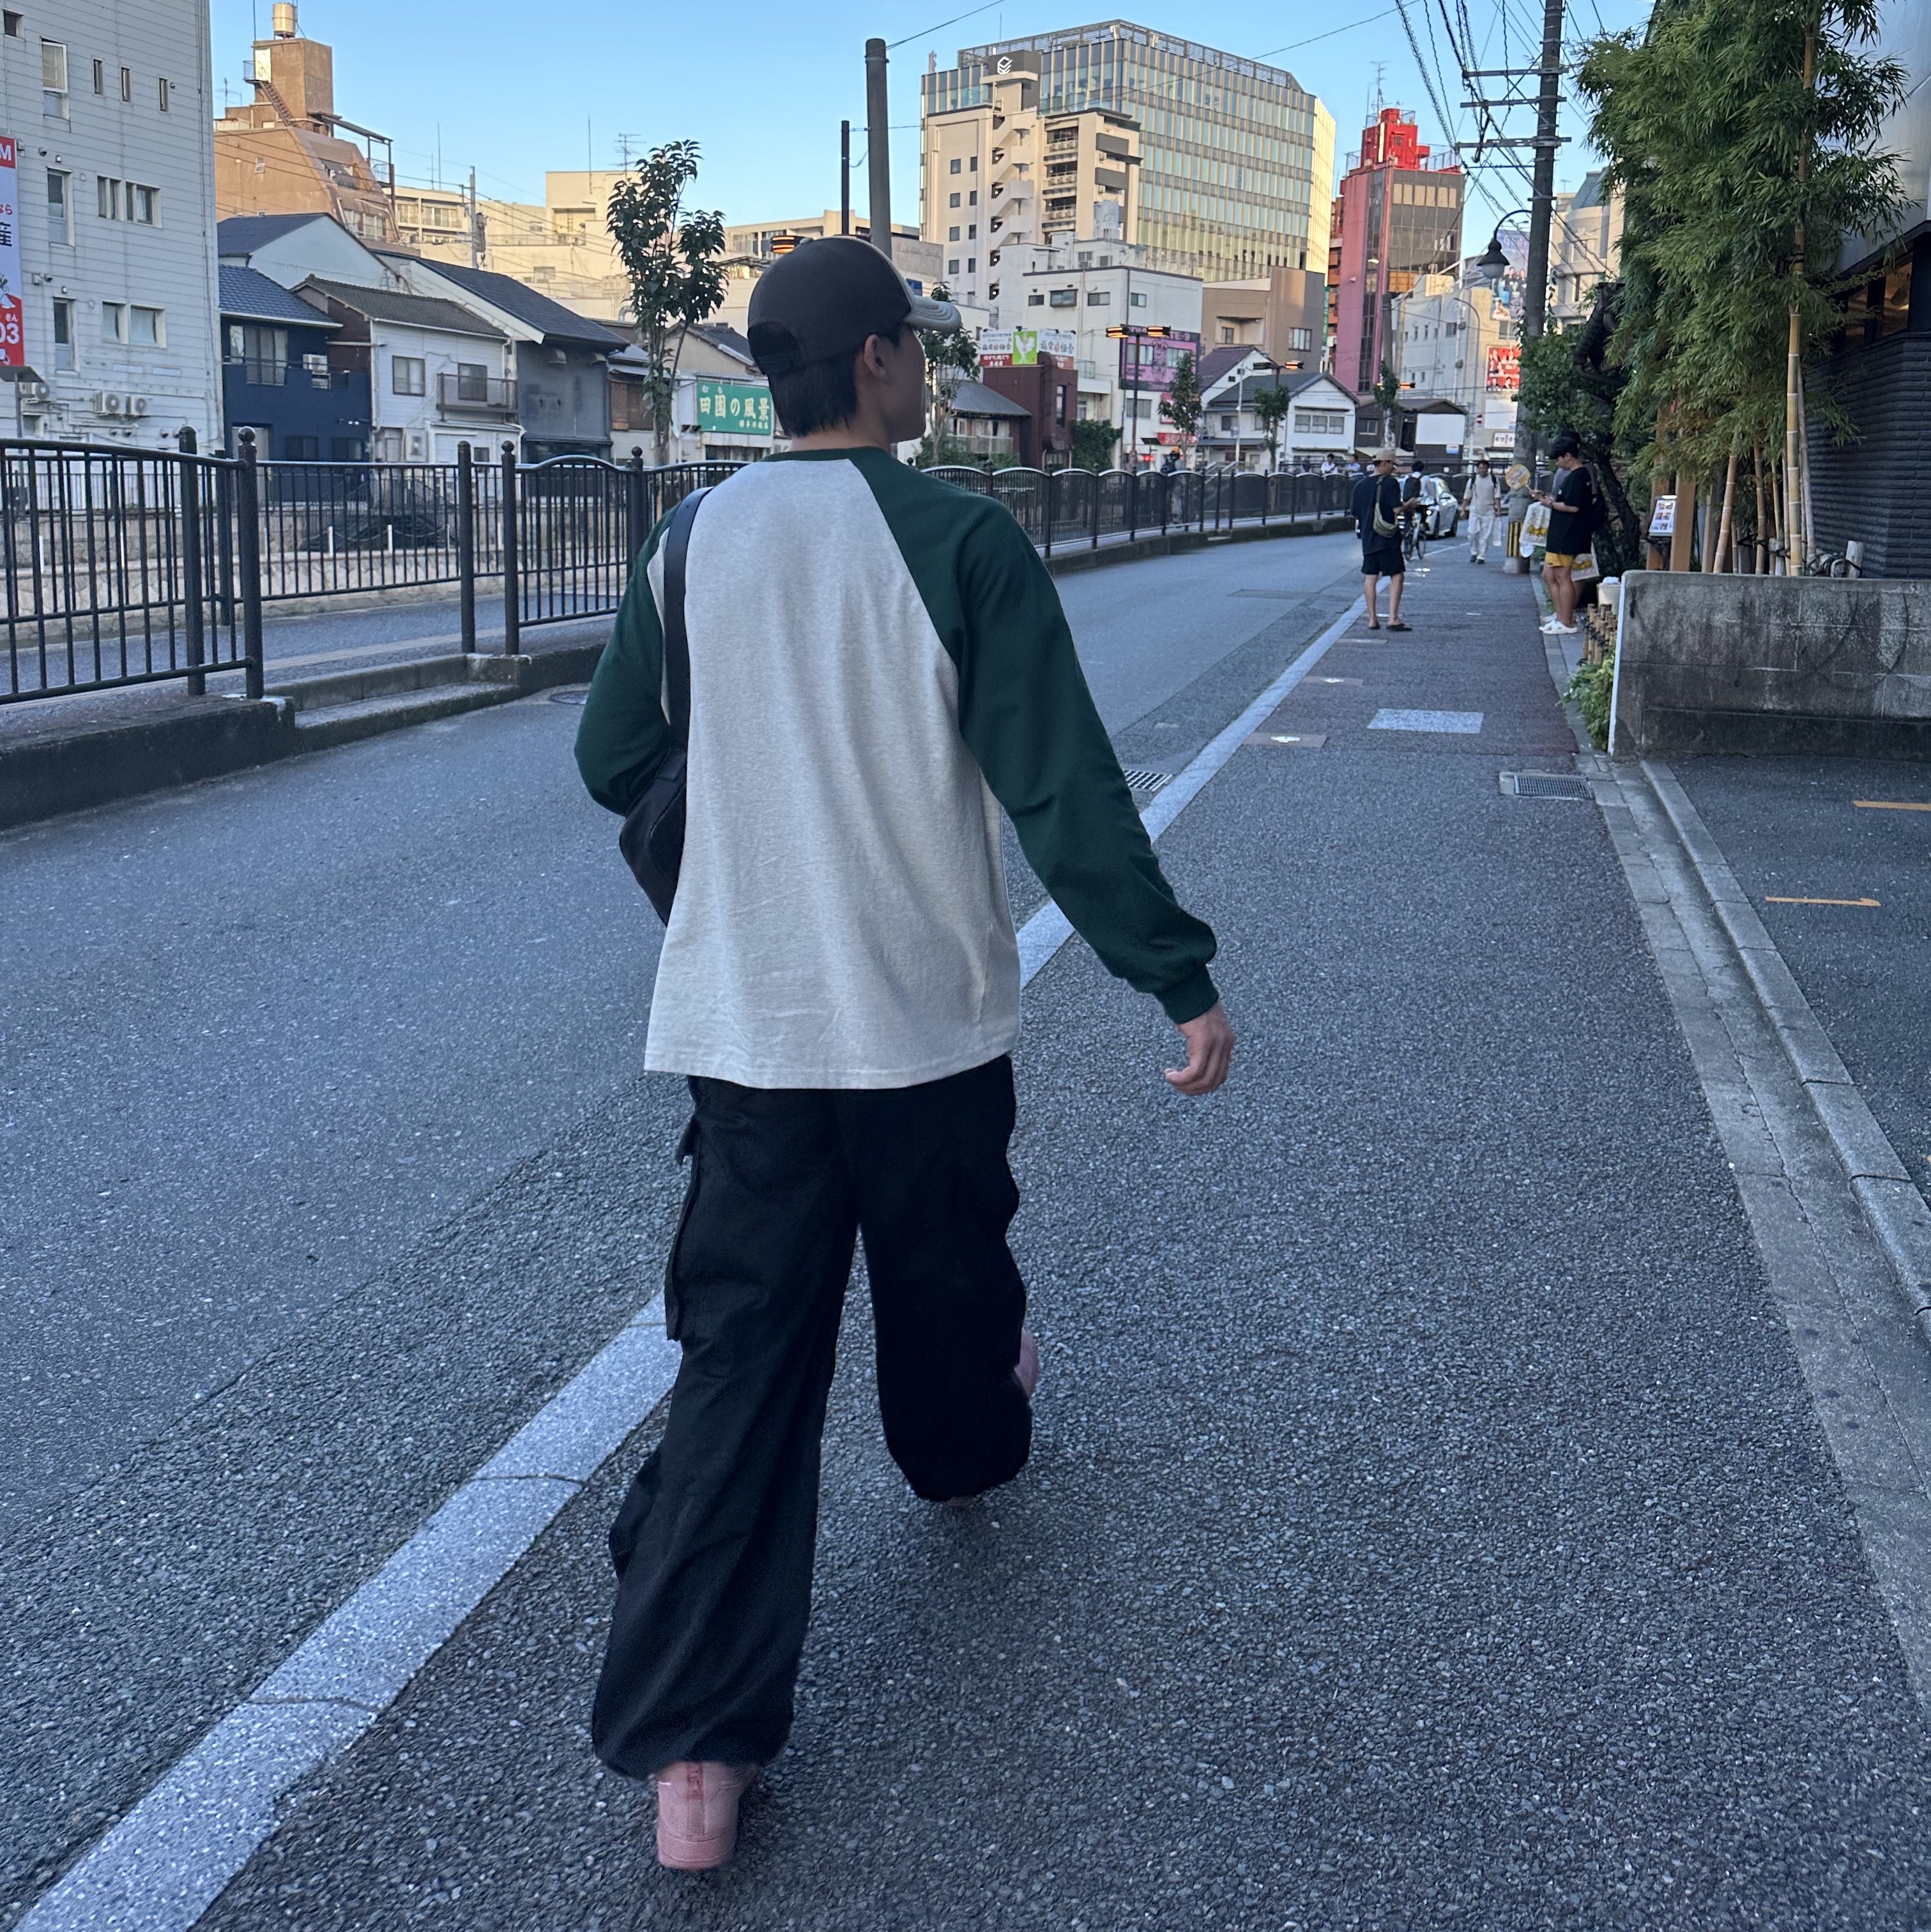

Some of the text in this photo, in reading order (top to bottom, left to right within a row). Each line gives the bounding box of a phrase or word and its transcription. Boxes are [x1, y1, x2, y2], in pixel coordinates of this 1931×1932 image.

[699, 394, 770, 421] 田園の風景
